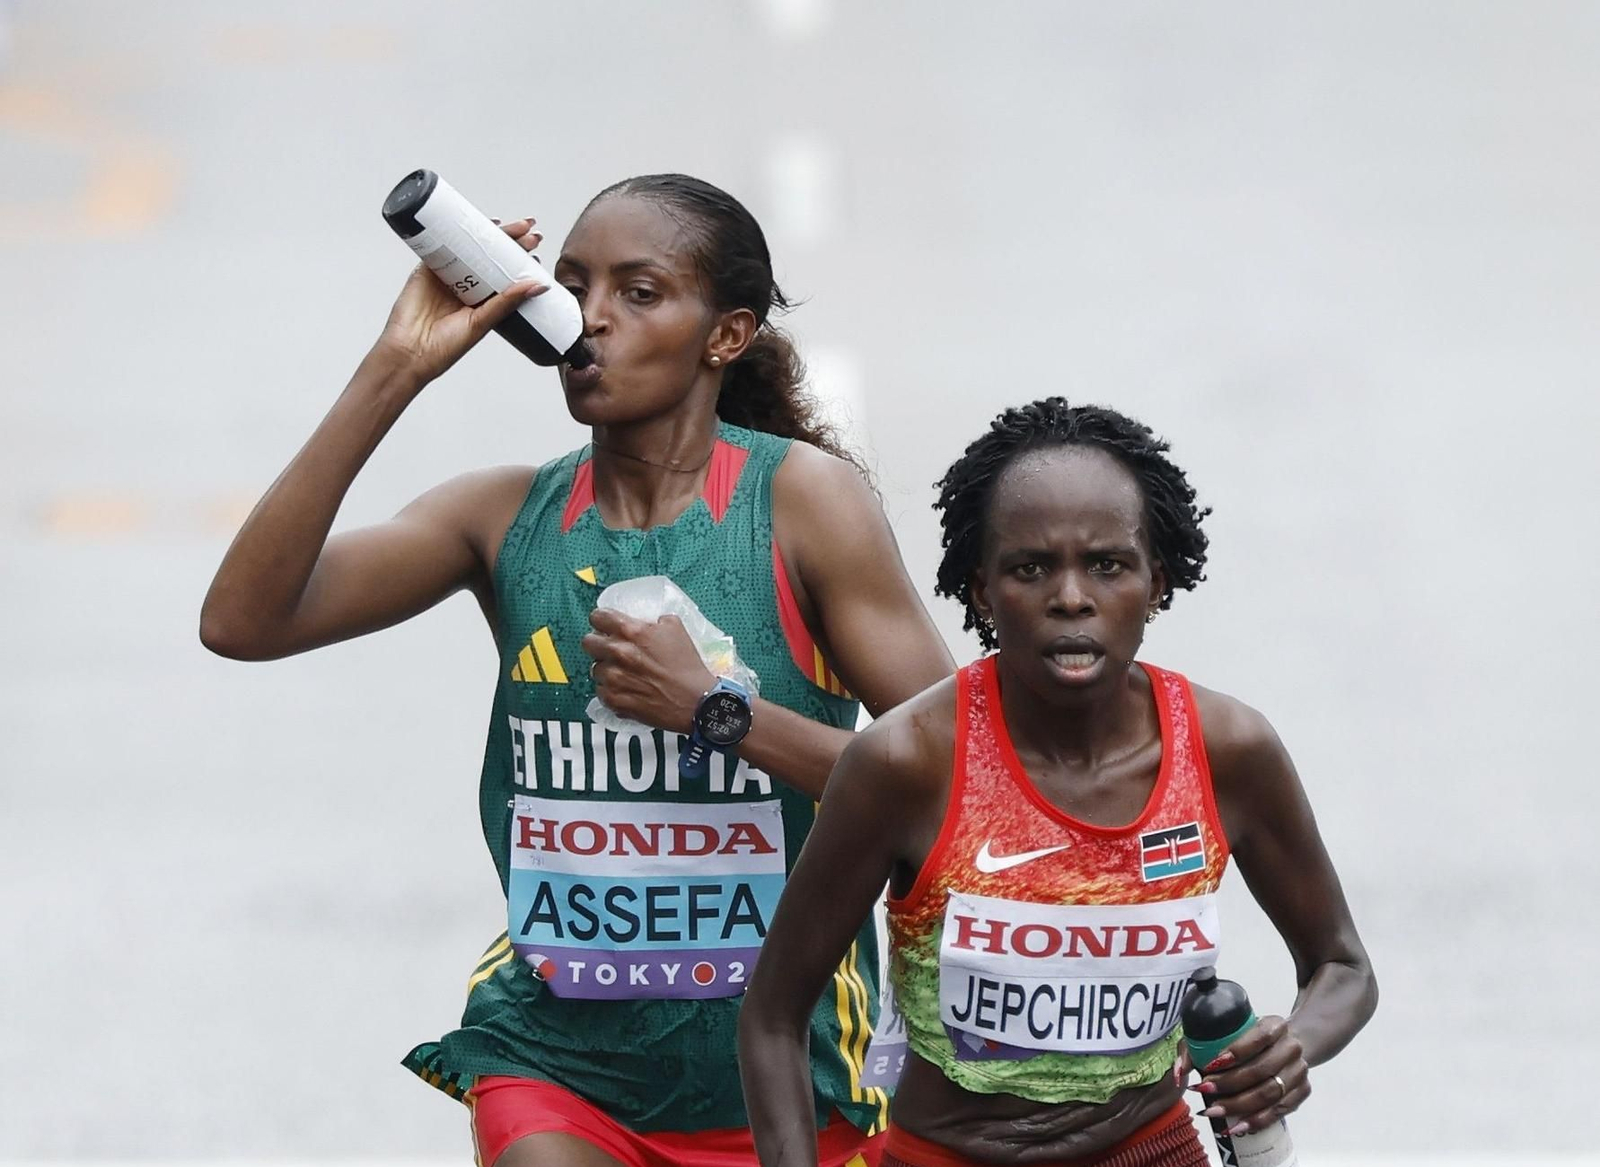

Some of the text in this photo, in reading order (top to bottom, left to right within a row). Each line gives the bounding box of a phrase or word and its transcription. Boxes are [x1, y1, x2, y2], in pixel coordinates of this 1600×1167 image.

[516, 815, 778, 856] HONDA
[520, 881, 767, 943] ASSEFA
[950, 915, 1215, 959] HONDA
